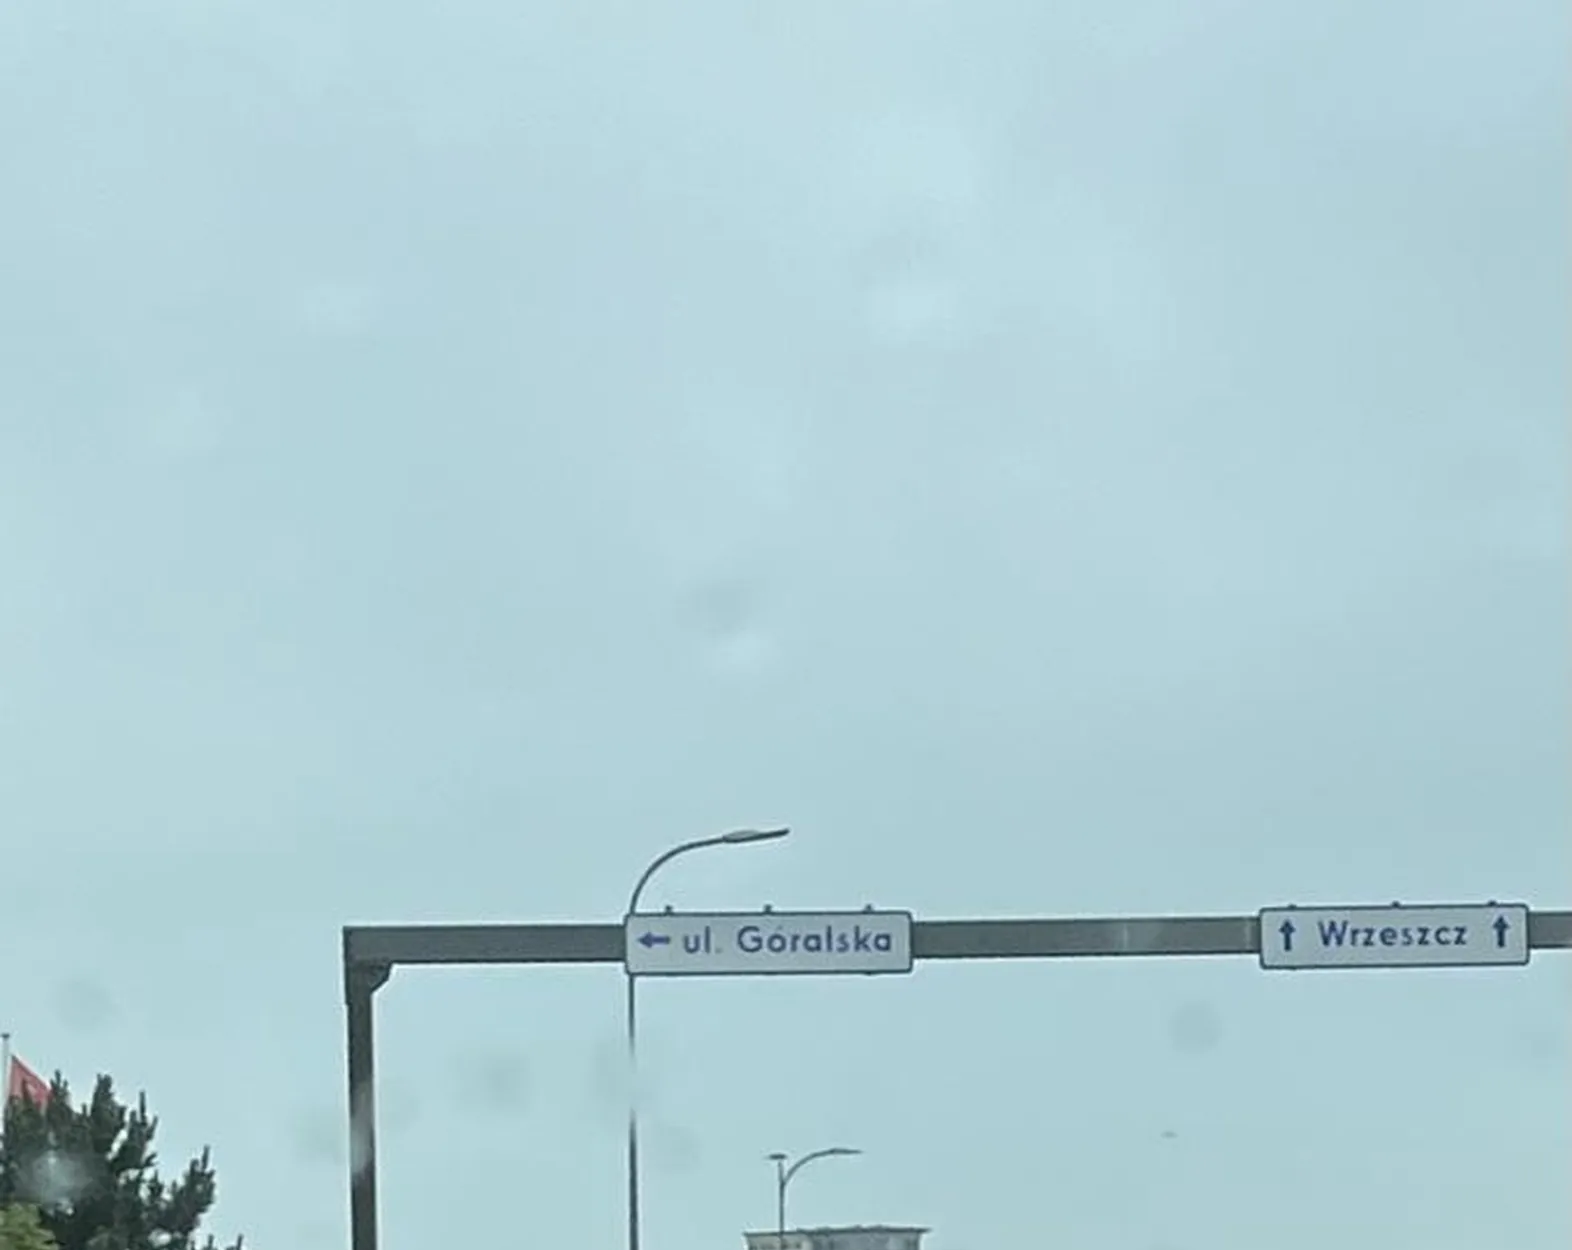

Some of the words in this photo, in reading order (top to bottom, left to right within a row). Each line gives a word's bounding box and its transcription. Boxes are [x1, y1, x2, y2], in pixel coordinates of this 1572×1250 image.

[683, 925, 721, 954] ul.
[737, 925, 892, 953] Góralska
[1317, 920, 1468, 947] Wrzeszcz
